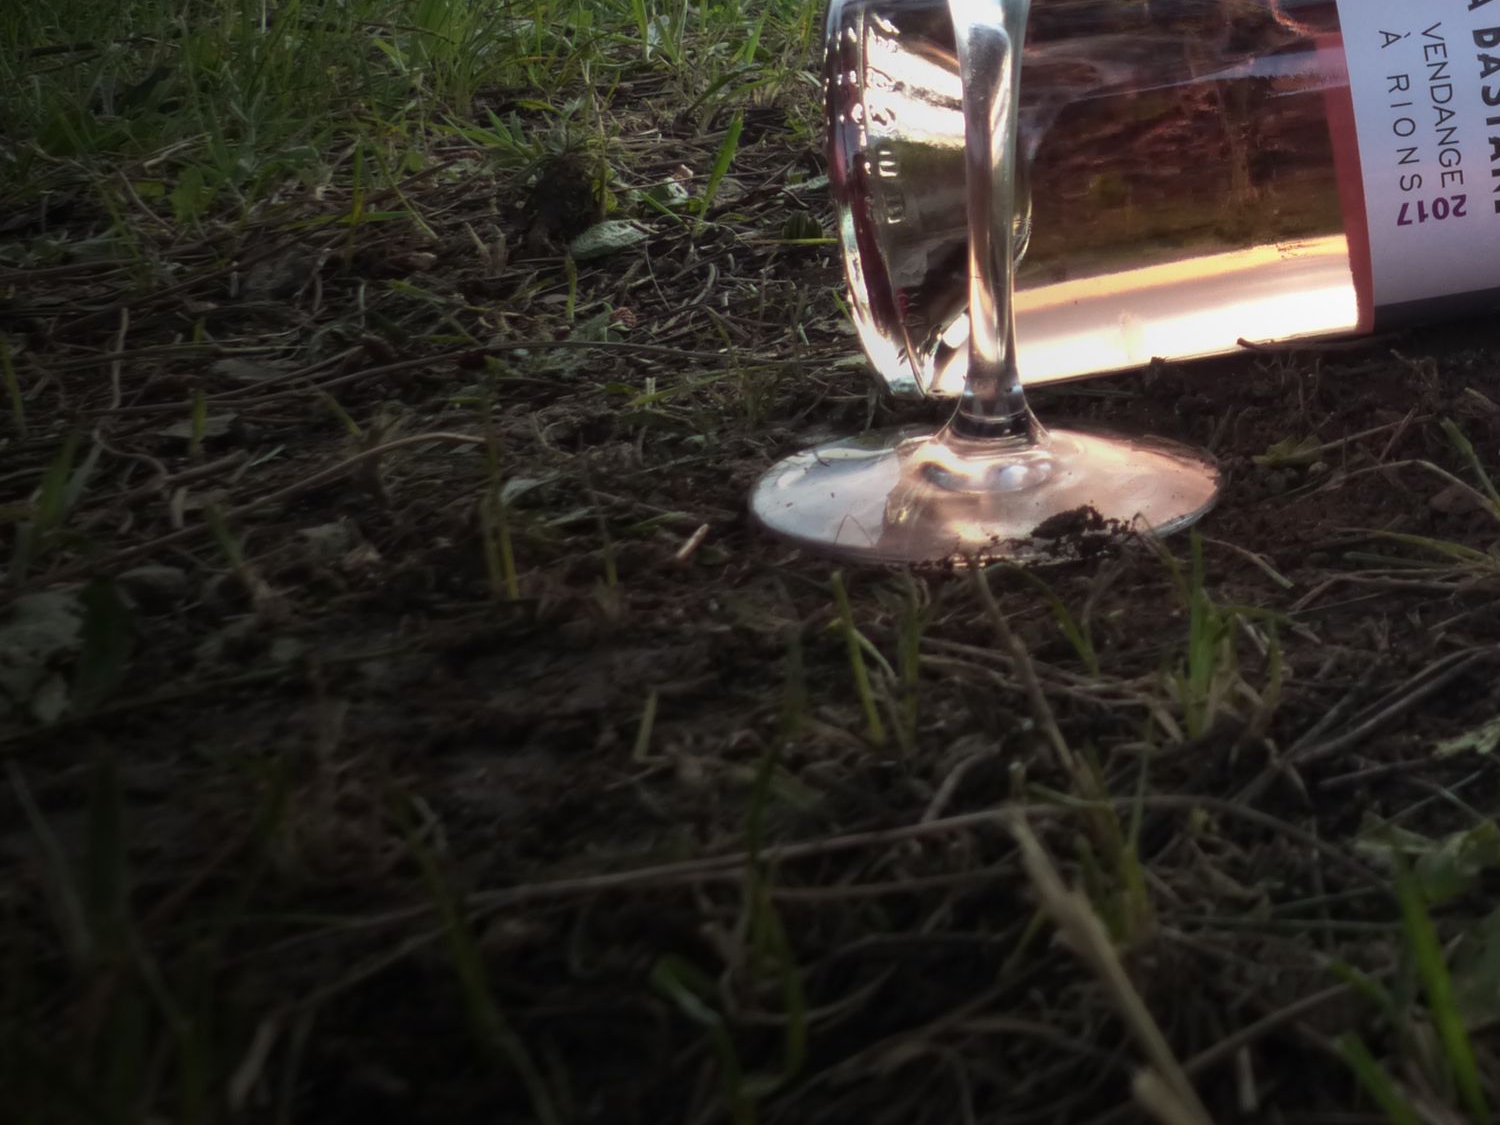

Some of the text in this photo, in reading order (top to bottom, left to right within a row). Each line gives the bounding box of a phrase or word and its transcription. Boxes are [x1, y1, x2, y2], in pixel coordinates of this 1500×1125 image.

[1386, 74, 1422, 192] RIONS
[1421, 21, 1464, 188] VENDANGE
[1397, 194, 1467, 226] 2017
